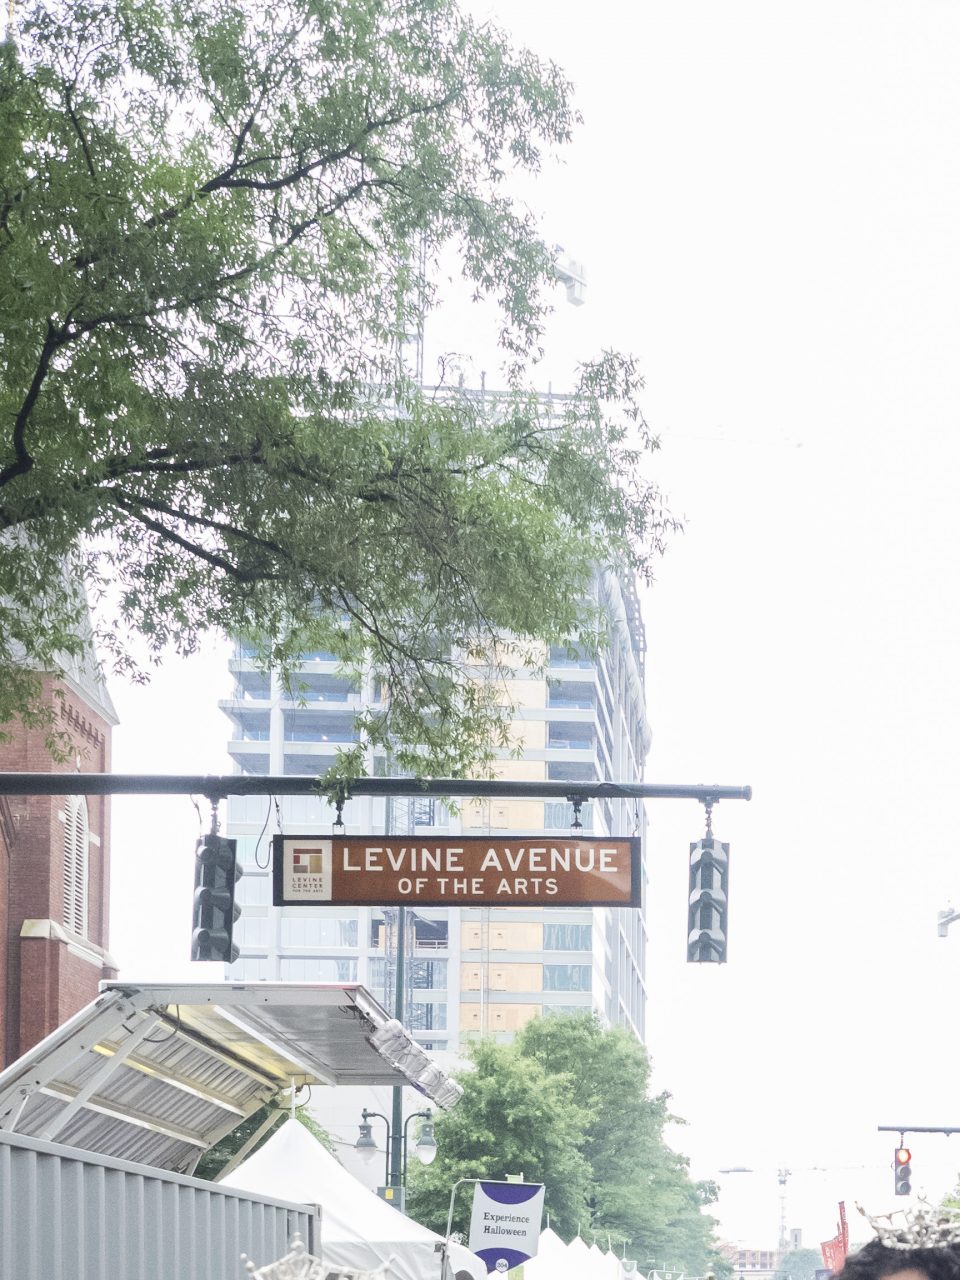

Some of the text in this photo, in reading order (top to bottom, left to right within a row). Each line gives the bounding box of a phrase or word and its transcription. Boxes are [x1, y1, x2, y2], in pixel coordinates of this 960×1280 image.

[343, 847, 618, 873] LEVINE AVENUE
[398, 878, 559, 895] OF THE ARTS
[483, 1212, 530, 1223] Experience
[483, 1225, 527, 1236] Halloween
